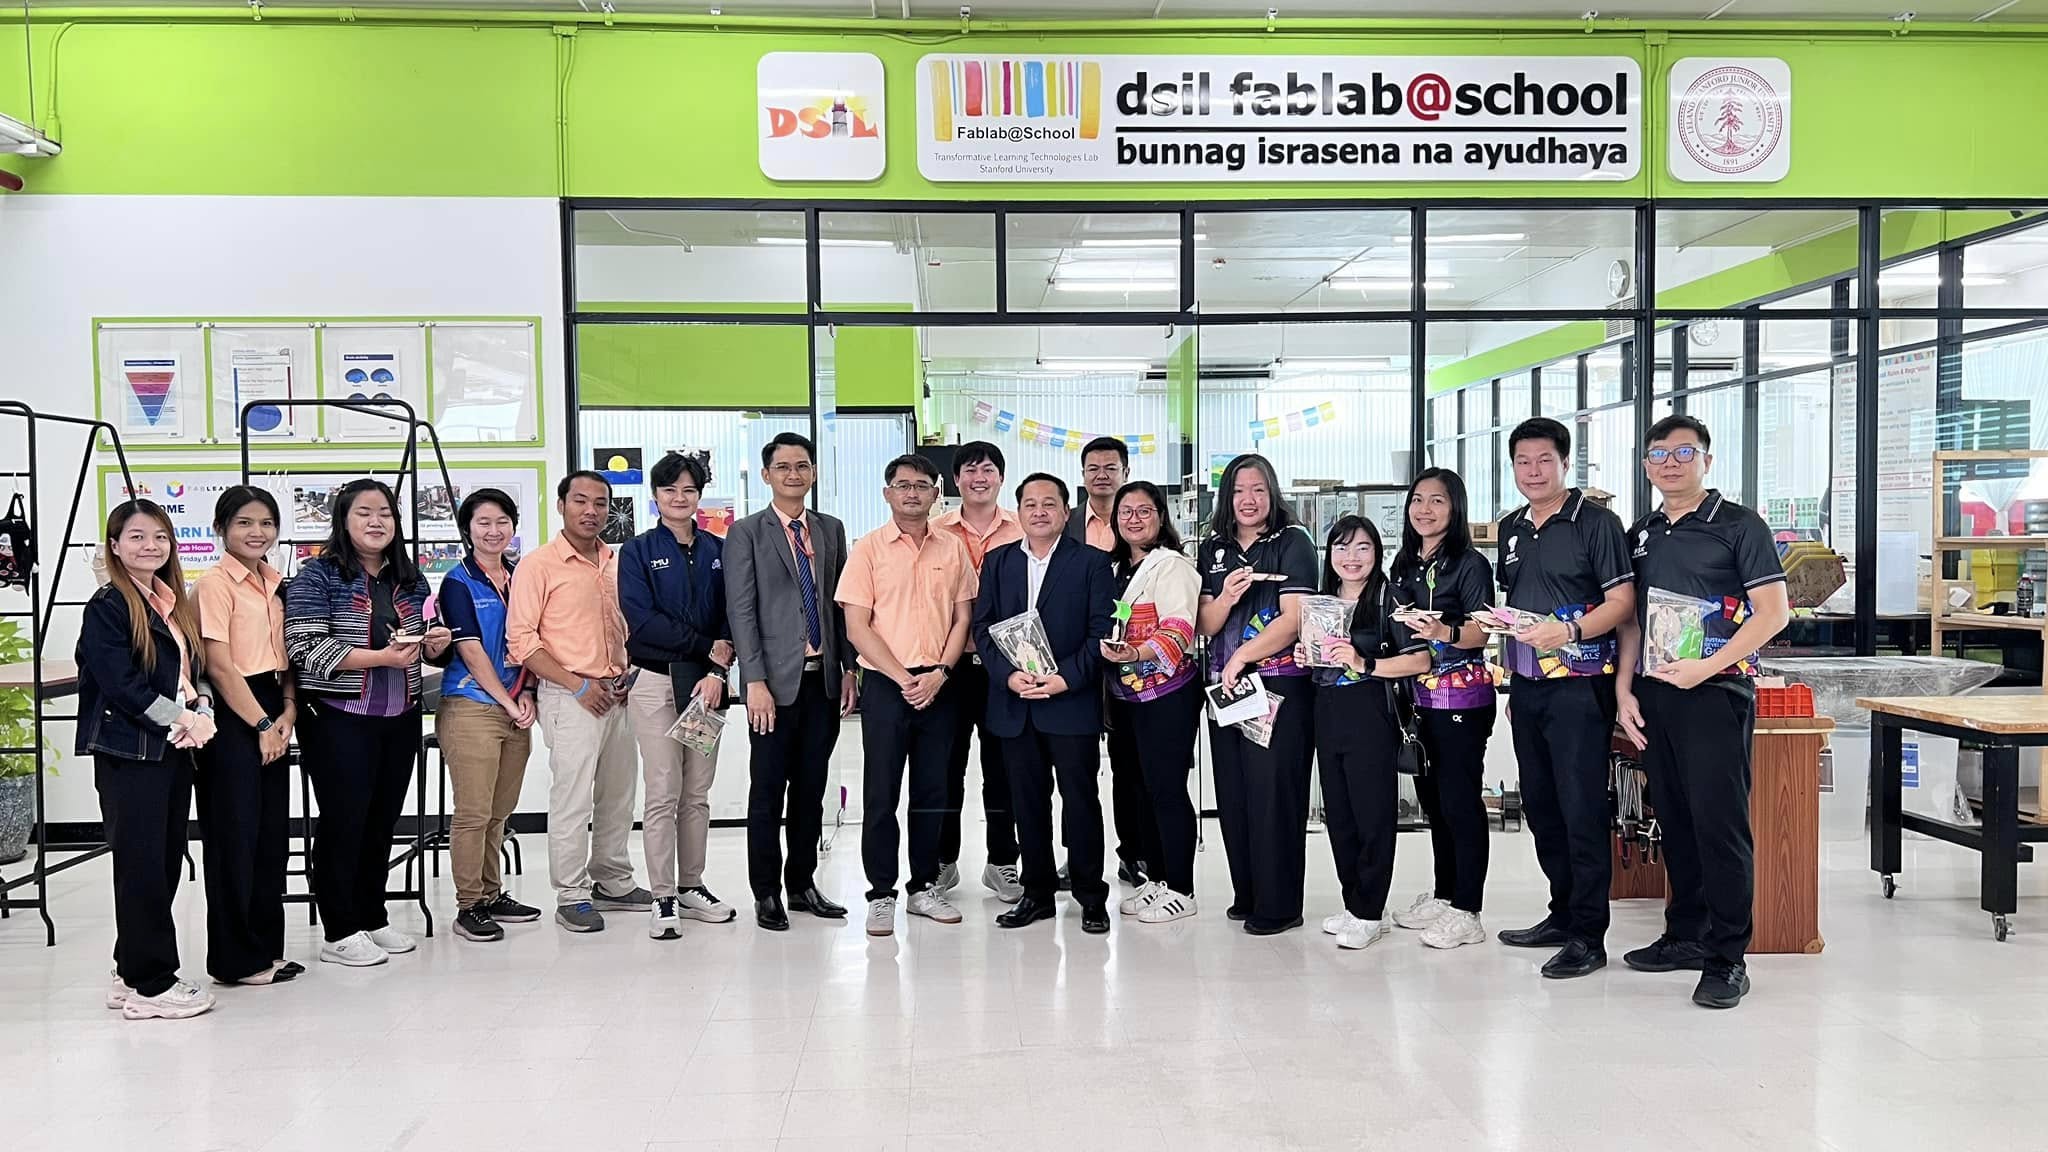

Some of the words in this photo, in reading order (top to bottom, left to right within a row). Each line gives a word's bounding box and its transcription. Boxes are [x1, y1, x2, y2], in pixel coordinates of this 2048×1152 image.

[1695, 75, 1729, 96] ANFORD
[1730, 74, 1758, 91] JUNIOR
[1117, 72, 1210, 116] dsil
[1229, 71, 1628, 122] fablab@school
[957, 126, 1075, 142] Fablab@School
[935, 153, 991, 161] Transformative
[994, 153, 1028, 162] Learning
[1031, 153, 1081, 162] Technologies
[1084, 153, 1099, 161] Lab
[1117, 137, 1245, 170] bunnag
[1259, 137, 1400, 165] israsena
[1413, 144, 1453, 165] na
[1464, 137, 1628, 170] ayudhaya
[980, 165, 1013, 173] Stanford
[1016, 165, 1054, 174] University
